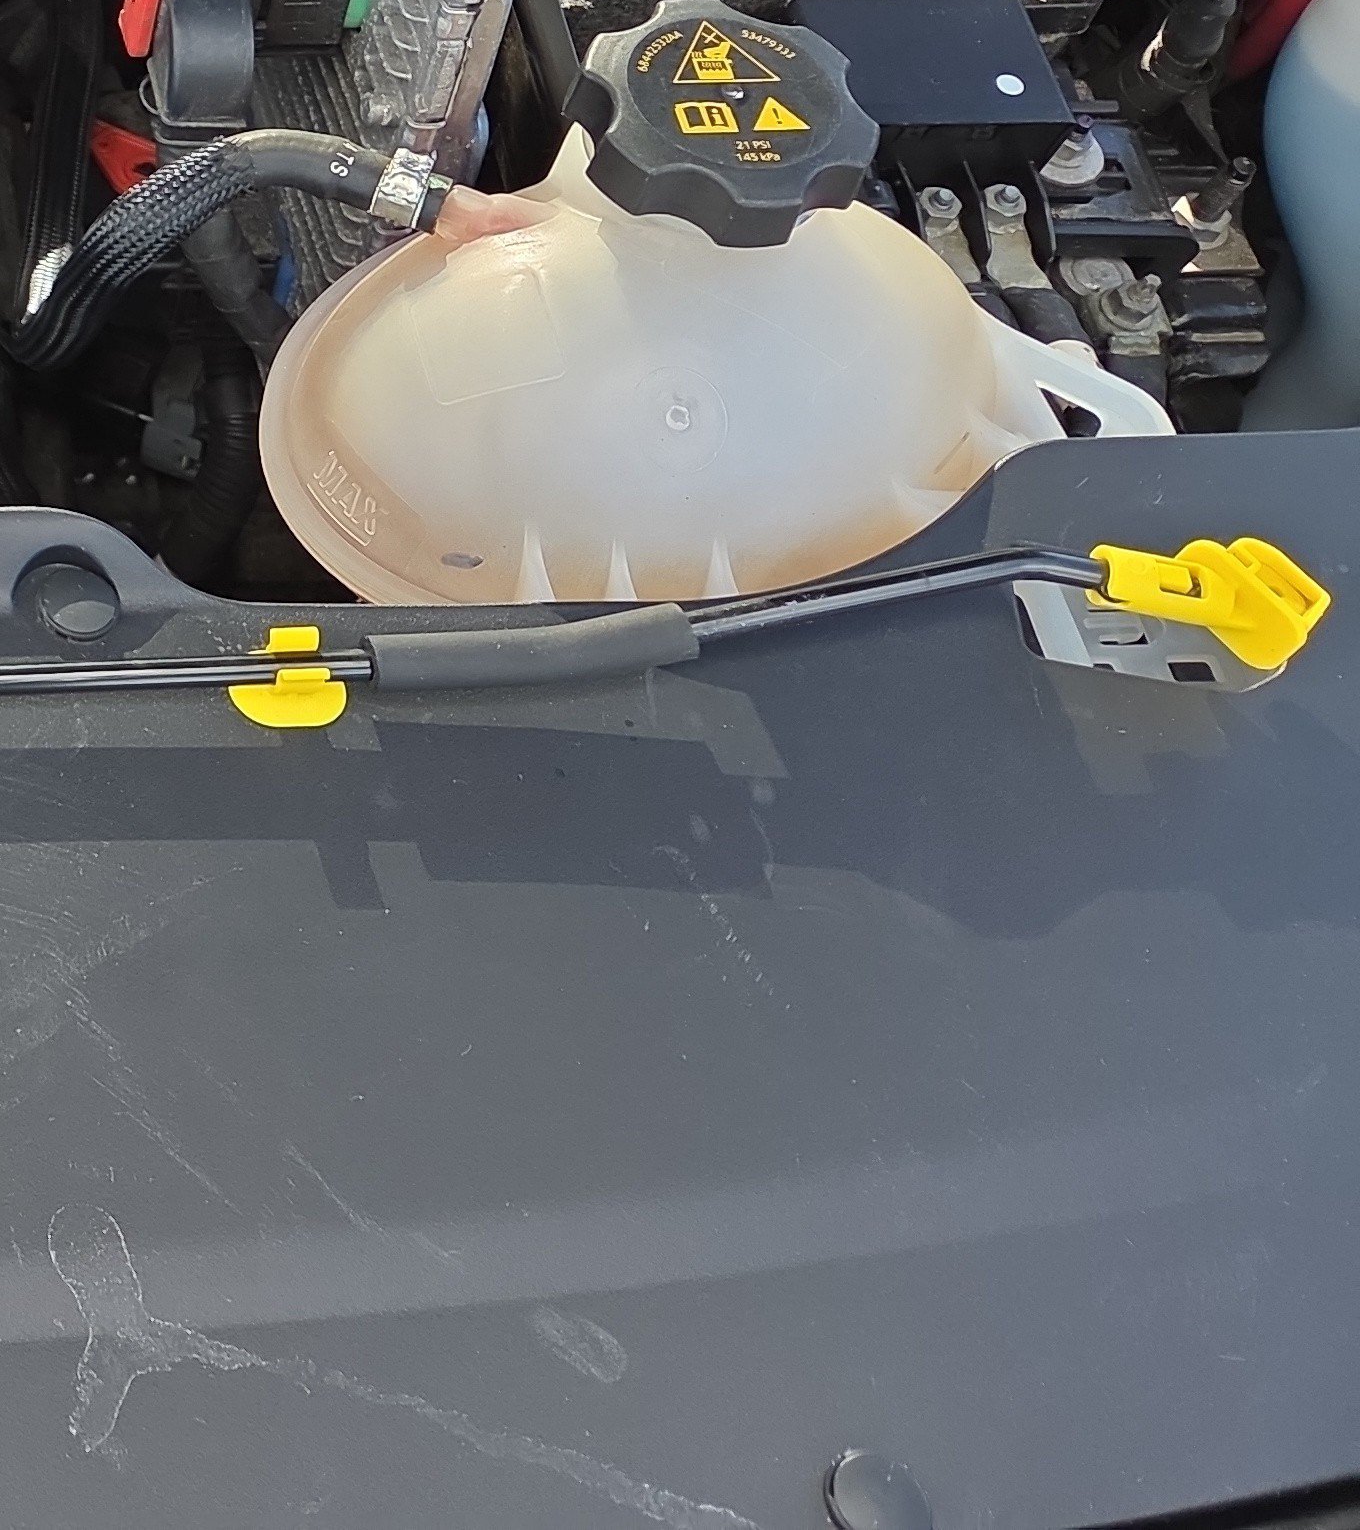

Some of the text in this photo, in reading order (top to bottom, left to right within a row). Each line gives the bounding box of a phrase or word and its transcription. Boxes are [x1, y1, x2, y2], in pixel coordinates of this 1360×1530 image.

[636, 30, 684, 73] 68442532AA
[741, 28, 796, 59] 53479332
[735, 140, 772, 150] 21 PSI
[736, 152, 781, 162] 145 kPa
[312, 450, 391, 537] MAX
